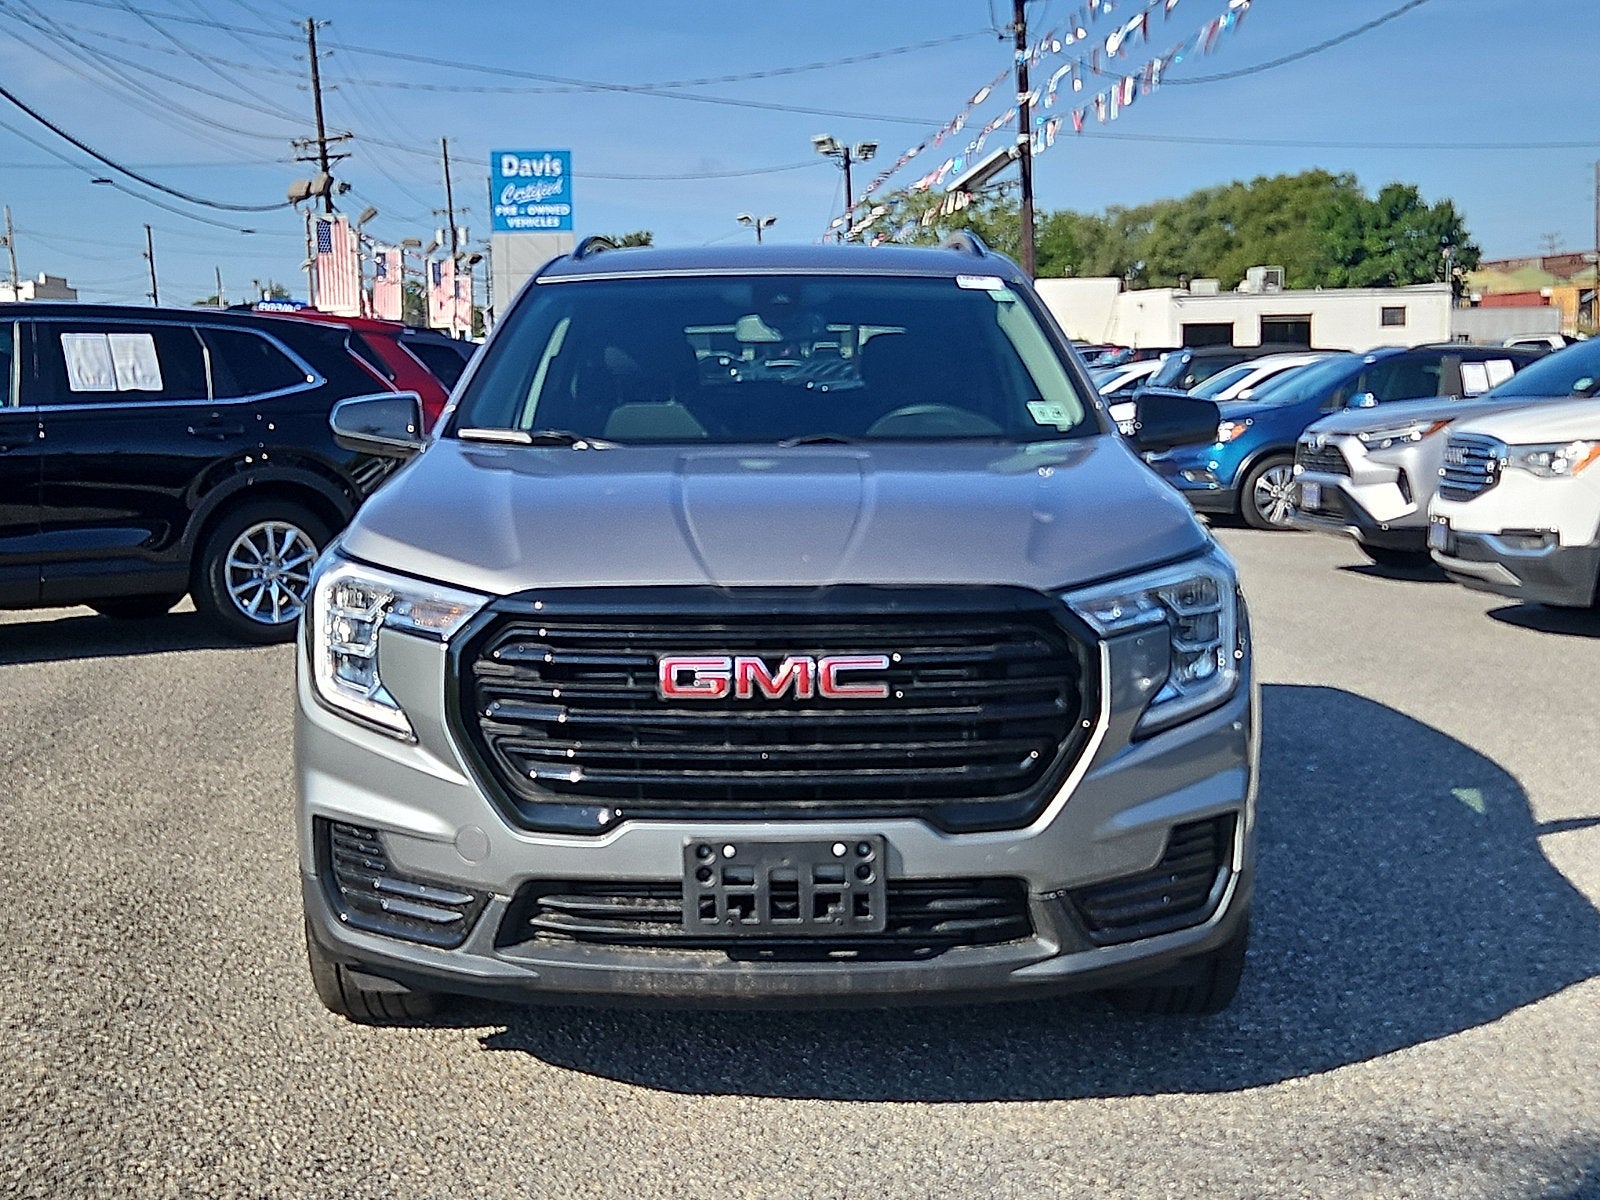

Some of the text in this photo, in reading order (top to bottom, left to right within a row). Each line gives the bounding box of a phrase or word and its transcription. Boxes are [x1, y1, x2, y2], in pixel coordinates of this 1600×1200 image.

[501, 153, 562, 177] Davis
[501, 176, 563, 205] Certified
[506, 216, 560, 228] VEHICLES
[658, 656, 890, 699] GMC
